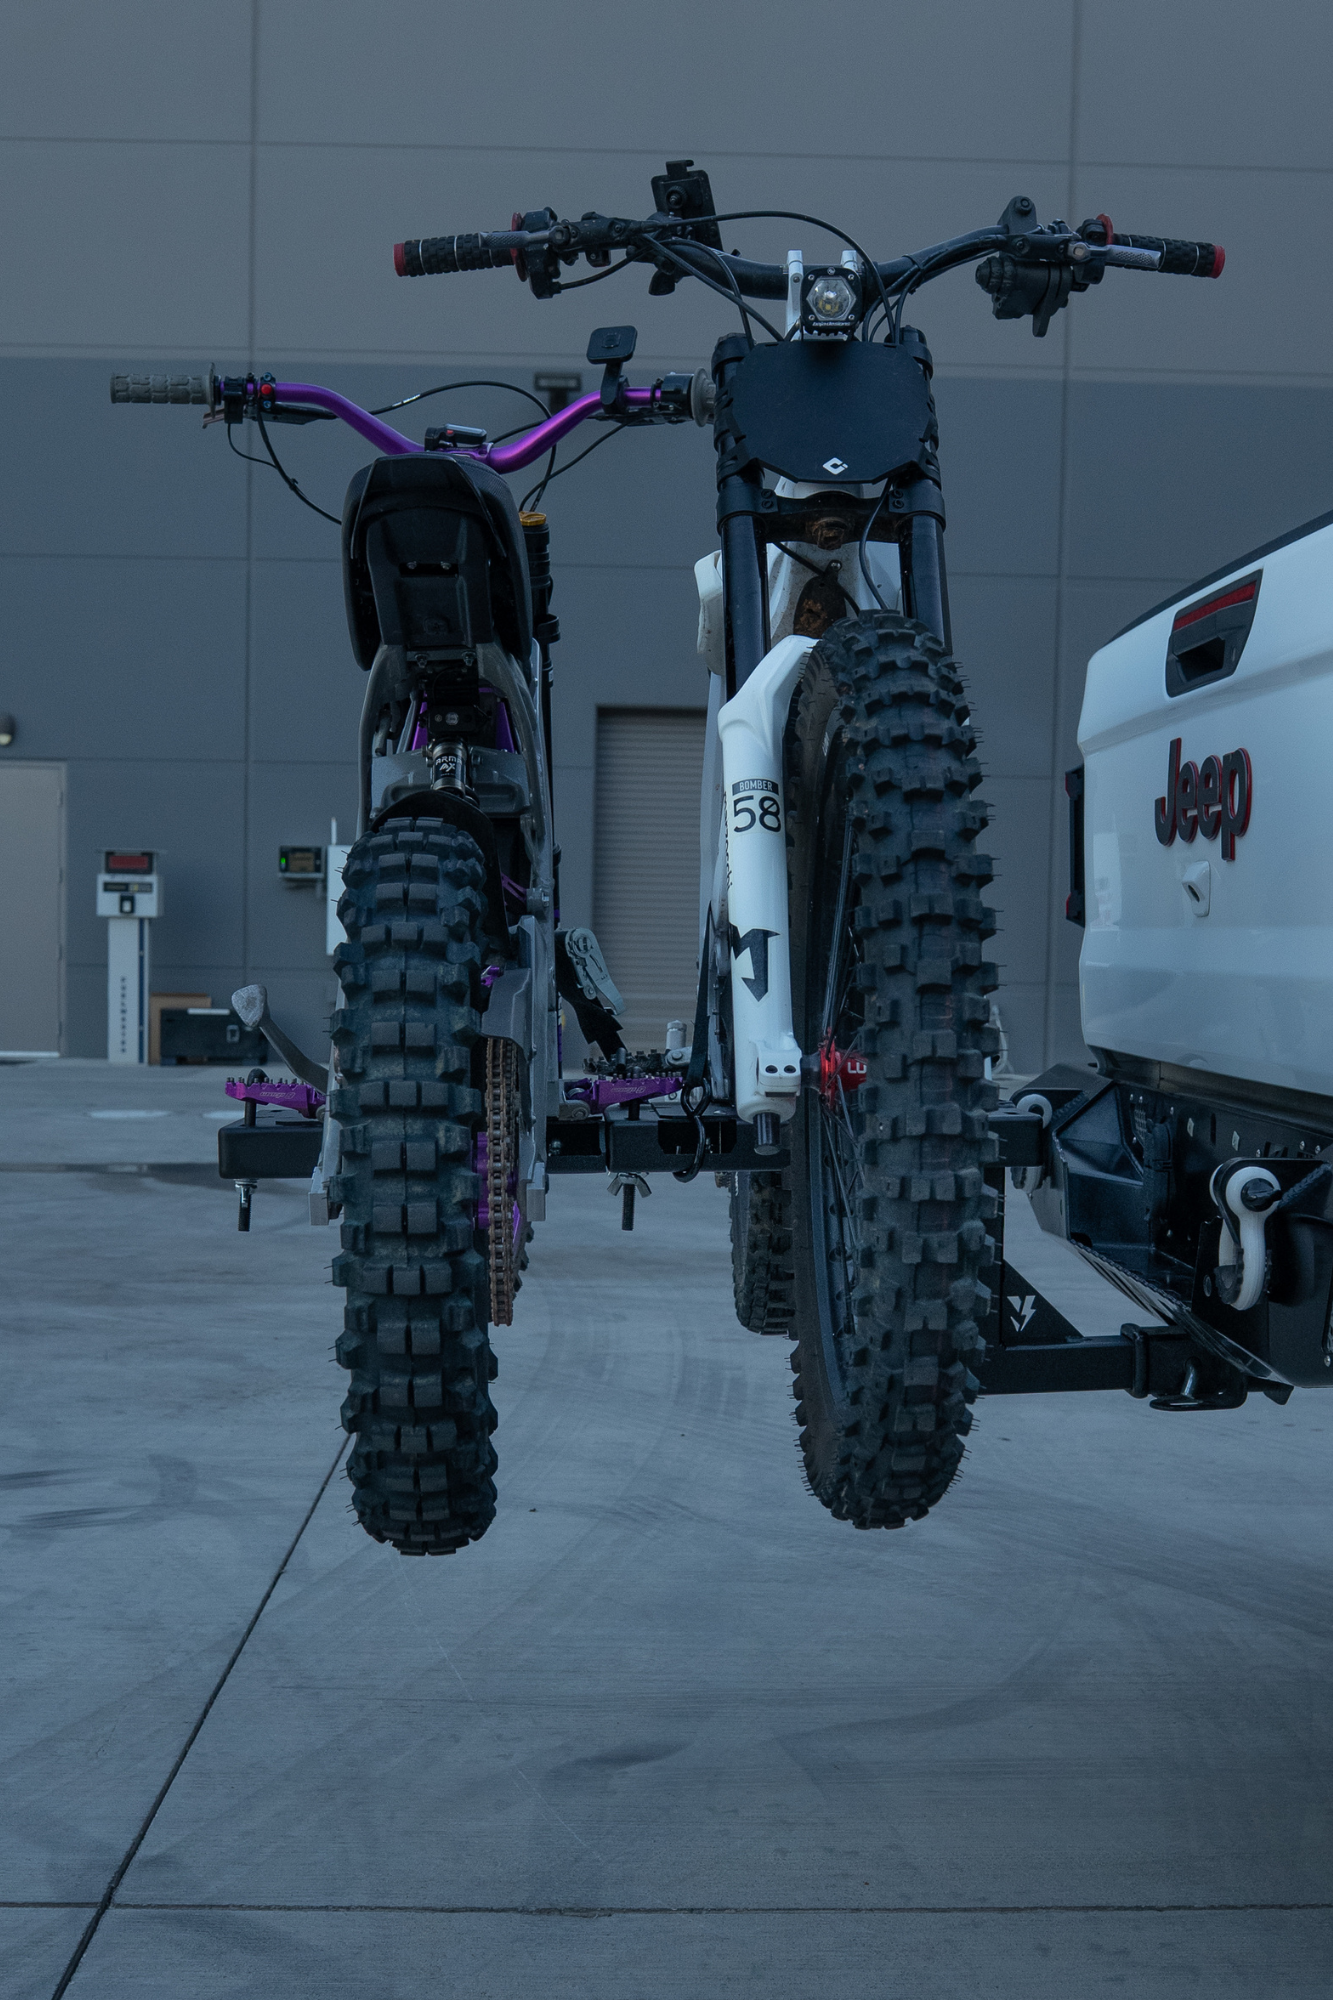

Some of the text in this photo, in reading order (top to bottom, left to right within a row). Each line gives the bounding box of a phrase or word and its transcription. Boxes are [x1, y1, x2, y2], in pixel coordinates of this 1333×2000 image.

[739, 780, 773, 792] BOMBER
[1154, 737, 1252, 861] Jeep
[733, 795, 782, 833] 58
